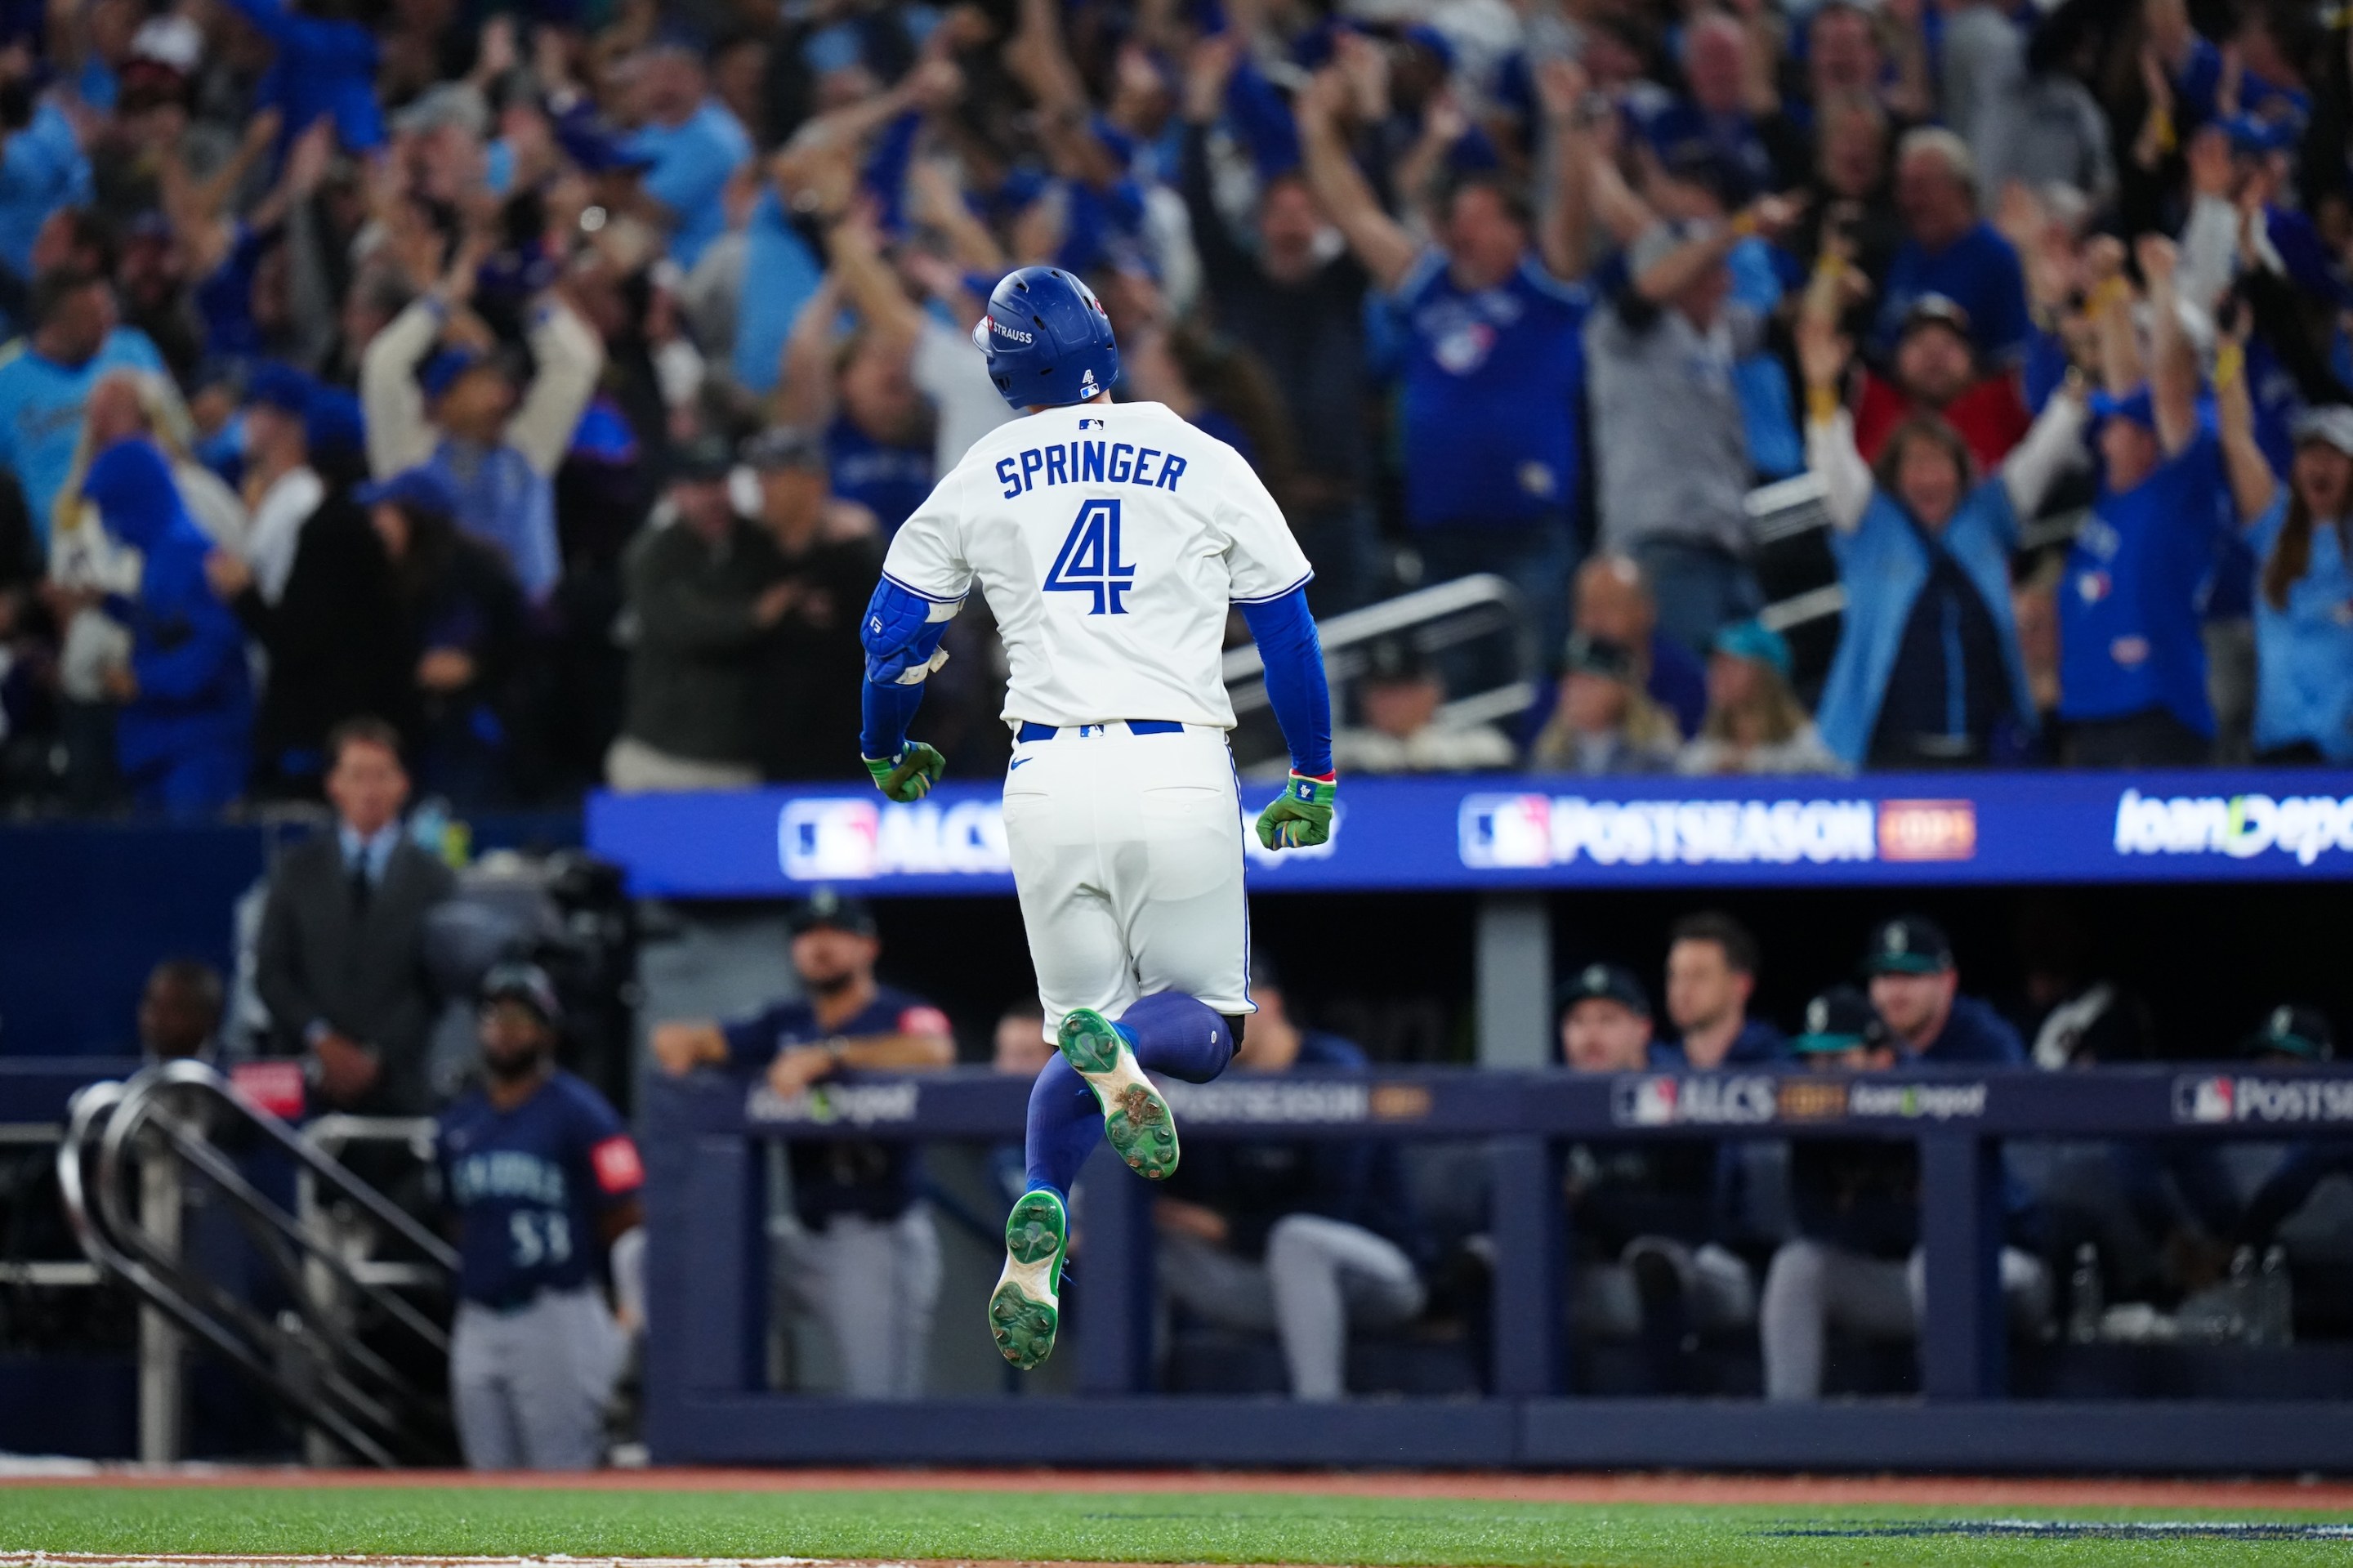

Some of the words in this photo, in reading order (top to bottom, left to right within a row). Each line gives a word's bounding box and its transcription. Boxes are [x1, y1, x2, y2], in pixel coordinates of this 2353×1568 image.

[993, 321, 1033, 345] STRAUSS
[1082, 369, 1095, 385] 4
[995, 440, 1188, 500] SPRINGER
[1042, 498, 1137, 616] 4
[1551, 797, 1876, 864] POSTSEASON
[1160, 1080, 1369, 1124] OSTSEASON
